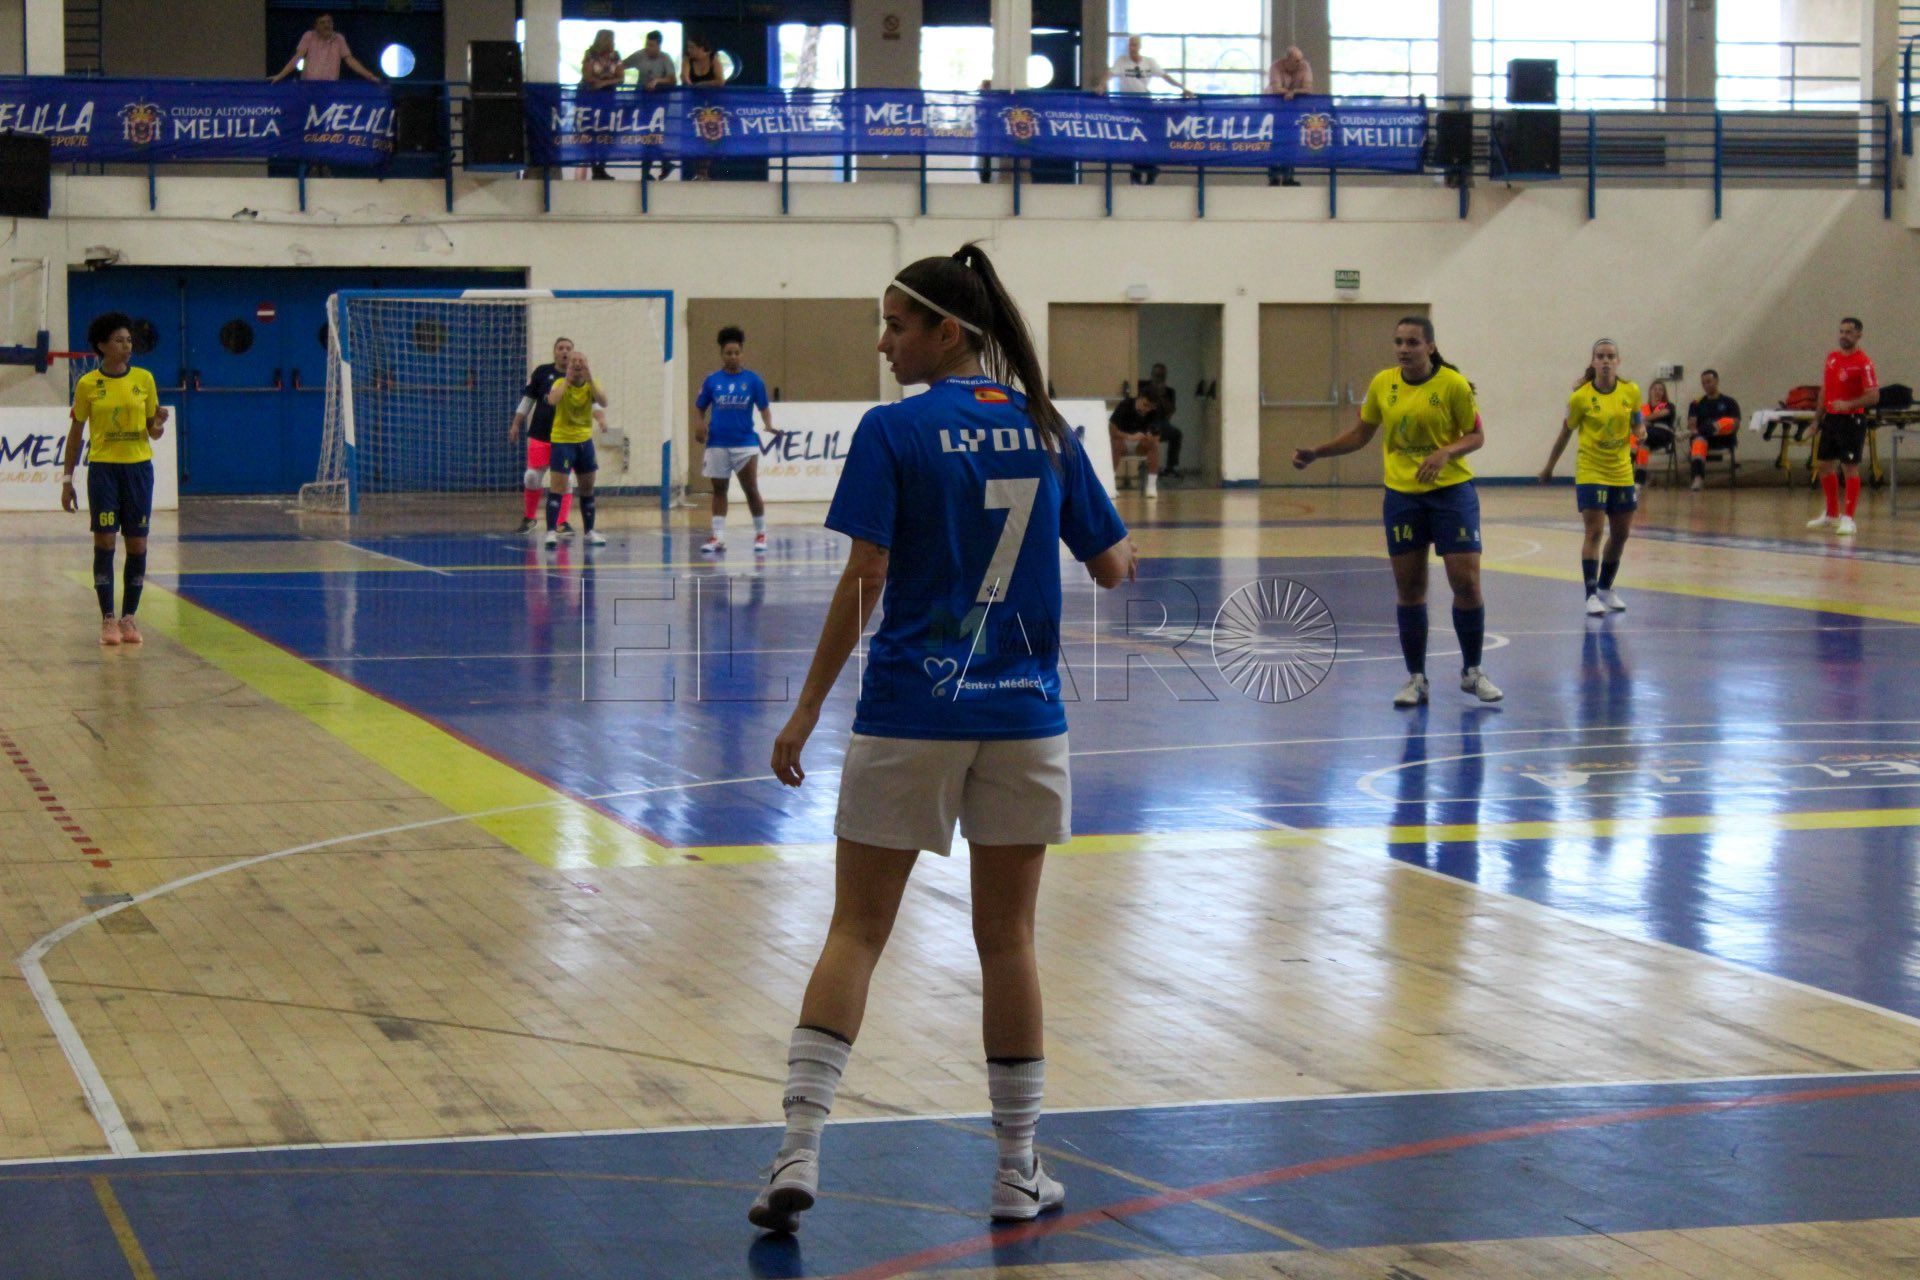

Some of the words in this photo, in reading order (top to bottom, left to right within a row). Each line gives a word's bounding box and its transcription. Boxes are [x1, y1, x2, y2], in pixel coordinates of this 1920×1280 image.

[171, 107, 212, 116] CIUDAD
[215, 105, 281, 116] AUTÓNOMA
[736, 107, 774, 115] CIUDAD
[552, 107, 665, 132] MELILLA
[1045, 111, 1082, 120] CIUDAD
[1085, 112, 1143, 124] AUTÓNOMA
[1340, 116, 1376, 126] CIUDAD
[1378, 113, 1424, 126] AUTÓNO
[174, 118, 281, 139] MELILLA
[741, 115, 845, 135] MELILLA
[1049, 120, 1148, 142] MELILLA
[1166, 114, 1274, 140] MELILLA
[868, 127, 906, 136] CIUDAD
[910, 128, 929, 137] DEL
[303, 133, 345, 144] CIUDAD
[347, 135, 368, 147] DEL
[1169, 141, 1205, 151] CIUDAD
[1209, 142, 1228, 151] DEL
[1231, 142, 1271, 152] DEPORTE
[1336, 271, 1359, 281] SALIDA
[728, 383, 736, 394] 9
[99, 511, 116, 527] 66
[975, 477, 1040, 603] 7
[1393, 524, 1413, 543] 14
[956, 679, 997, 690] Centro
[999, 677, 1041, 689] Médico
